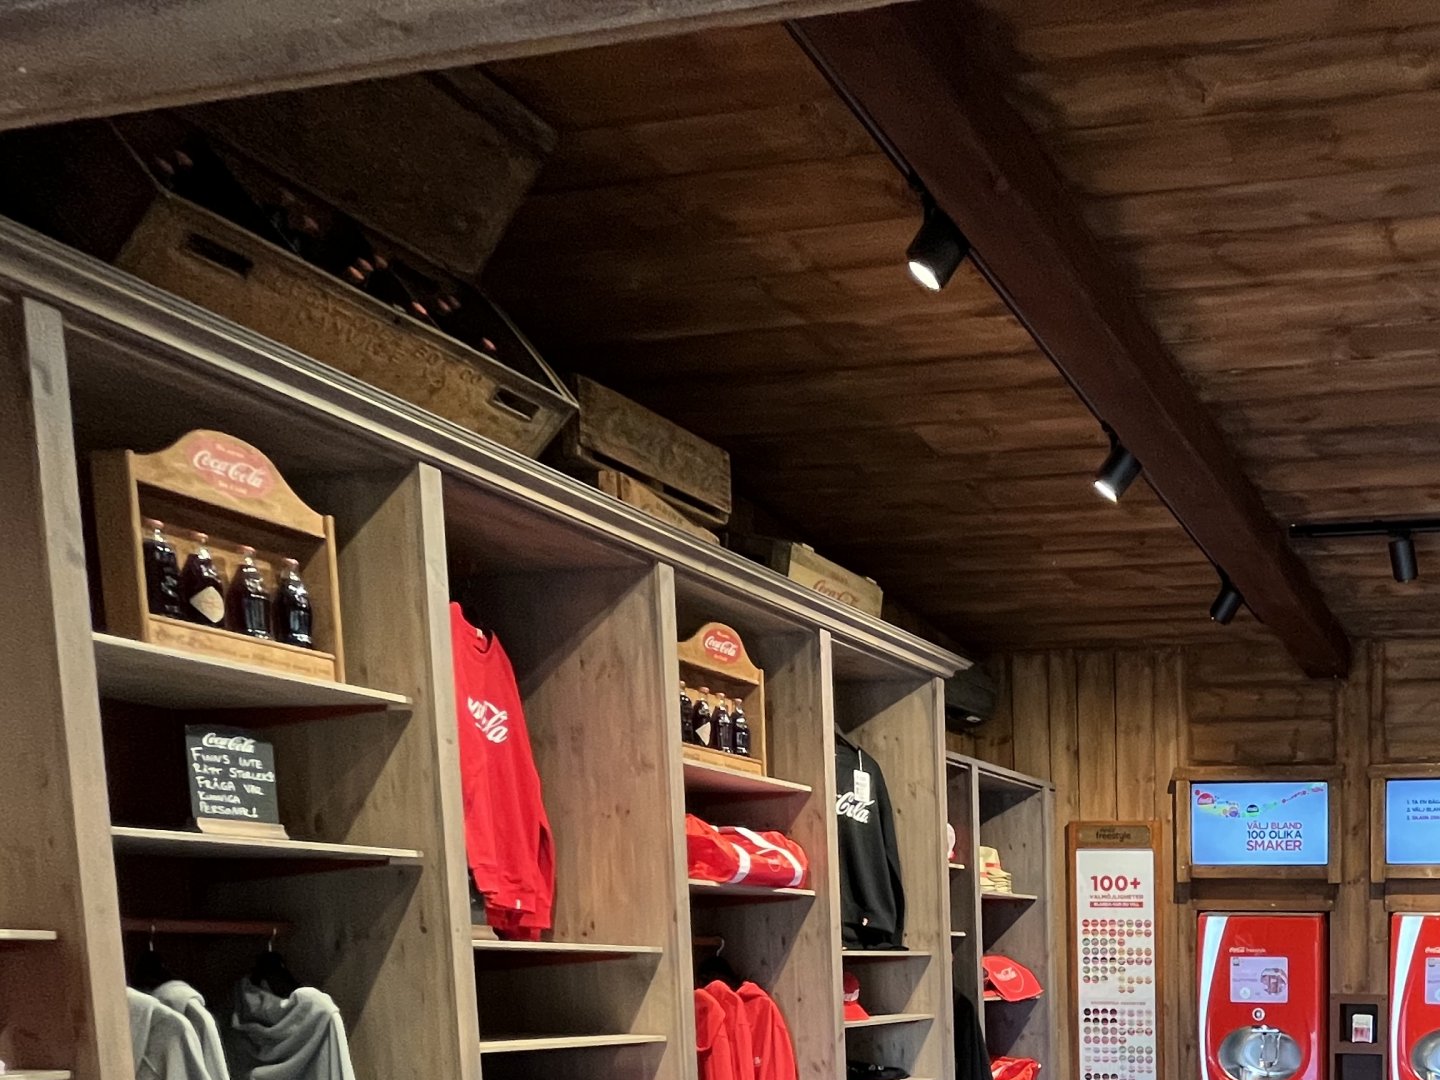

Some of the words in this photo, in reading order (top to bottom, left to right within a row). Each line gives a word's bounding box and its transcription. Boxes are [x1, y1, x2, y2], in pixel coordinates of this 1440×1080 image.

[193, 451, 266, 488] Coca-Cola
[705, 636, 739, 656] Coca-Cola
[202, 733, 256, 753] Coca-Cola
[1247, 821, 1268, 829] VÄLJ
[1096, 831, 1131, 842] freestyle
[1247, 830, 1265, 839] 100
[1269, 830, 1302, 839] OLIKA
[1246, 840, 1302, 851] SMAKER
[1090, 875, 1141, 892] 100+
